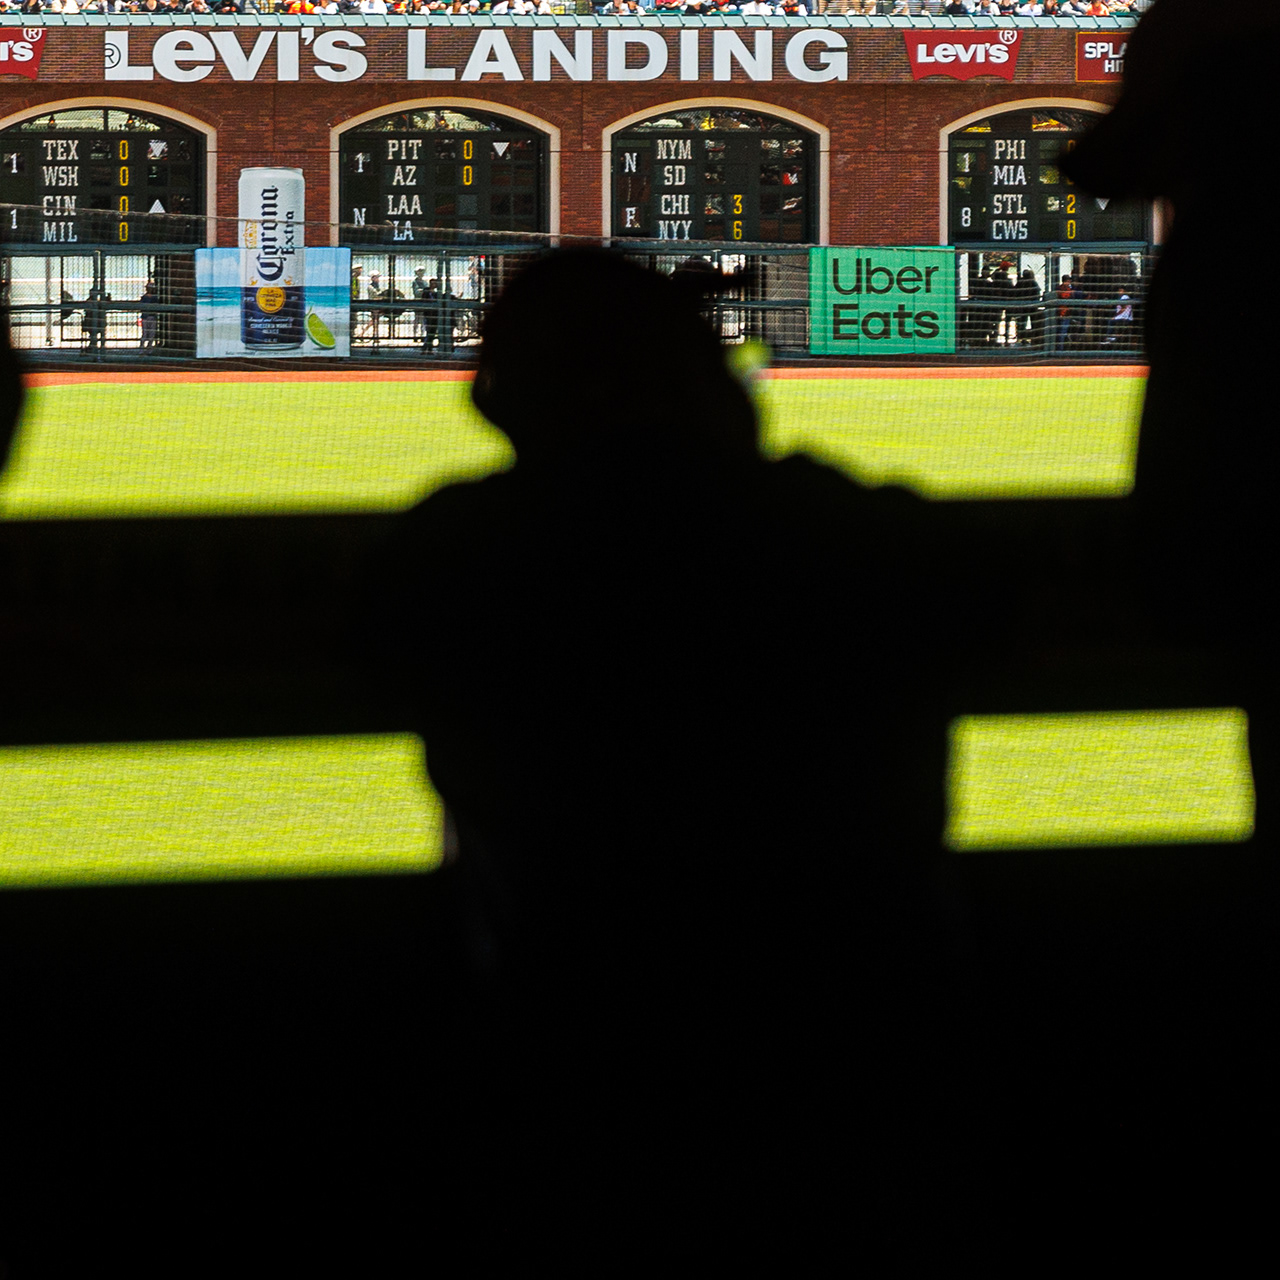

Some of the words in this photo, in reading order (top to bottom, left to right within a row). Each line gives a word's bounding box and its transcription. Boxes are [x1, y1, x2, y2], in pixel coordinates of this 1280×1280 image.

[407, 28, 849, 83] LANDING
[42, 140, 79, 161] TEX
[119, 140, 129, 161] 0
[387, 139, 422, 160] PIT
[463, 139, 473, 160] 0
[657, 139, 692, 160] NYM
[994, 139, 1026, 160] PHI
[10, 152, 18, 174] 1
[624, 152, 637, 173] N
[963, 152, 971, 173] 1
[43, 166, 79, 187] WSH
[119, 166, 129, 187] 0
[392, 165, 417, 186] AZ
[463, 165, 473, 186] 0
[663, 165, 686, 186] SD
[993, 165, 1027, 185] MIA
[43, 195, 77, 216] CIN
[119, 195, 129, 216] 0
[387, 194, 423, 215] LAA
[661, 194, 689, 215] CHI
[733, 194, 742, 214] 3
[993, 194, 1027, 214] STL
[1066, 194, 1076, 214] 2
[10, 209, 18, 230] 1
[353, 208, 366, 228] N
[961, 207, 971, 227] 8
[42, 221, 78, 242] MIL
[119, 222, 129, 242] 0
[256, 186, 287, 281] Corona
[281, 211, 295, 255] Extra
[392, 220, 414, 241] LA
[658, 220, 692, 240] NYY
[733, 220, 742, 240] 6
[992, 219, 1028, 240] CWS
[1066, 219, 1076, 240] 0
[833, 257, 939, 295] Uber
[833, 303, 940, 340] Eats
